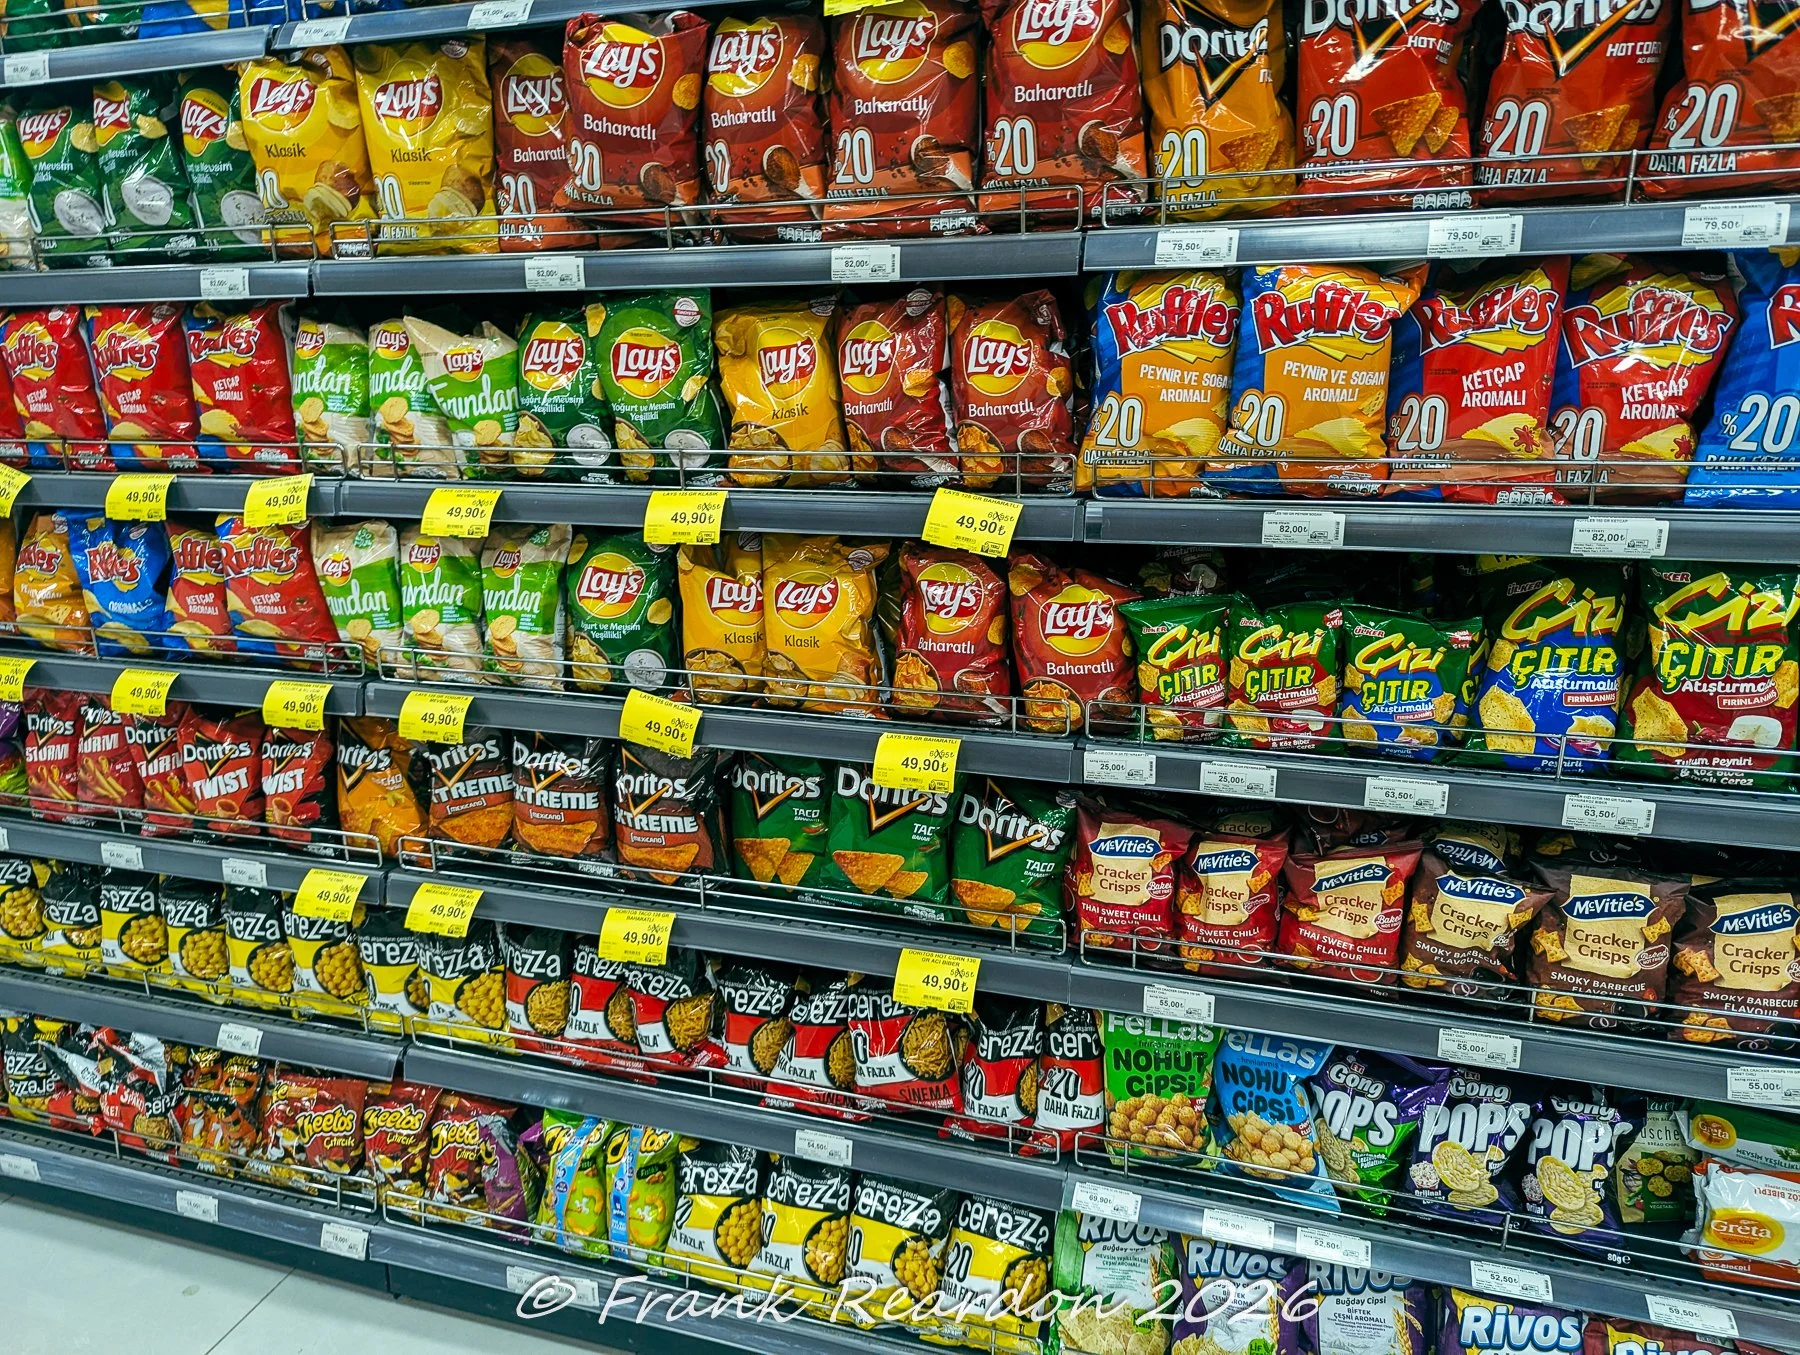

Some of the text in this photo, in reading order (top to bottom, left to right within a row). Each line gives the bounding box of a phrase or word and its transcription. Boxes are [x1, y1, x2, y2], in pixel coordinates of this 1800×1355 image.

[859, 14, 932, 62] Lay's
[1407, 36, 1435, 48] HOT
[709, 27, 776, 72] Lay's
[1606, 43, 1633, 56] HOT
[586, 42, 658, 87] Lay's
[1014, 80, 1093, 102] Baharatlı
[855, 96, 927, 115] Baharatlı
[711, 110, 776, 127] Baharatlı
[584, 115, 656, 140] Baharatlı
[265, 145, 306, 158] Klasik
[391, 147, 431, 162] Klasik
[1649, 154, 1736, 173] DAHA FAZLA
[1704, 220, 1741, 231] 79,50₺
[1447, 231, 1479, 242] 79,50₺
[1106, 284, 1240, 357] Ruffles
[1252, 282, 1401, 352] Ruffles
[1419, 284, 1558, 352] Ruffles
[1563, 286, 1733, 366] Ruffles
[616, 342, 677, 382] Lay's
[967, 336, 1030, 377] Lay's
[1183, 371, 1198, 386] VE
[1284, 361, 1346, 385] PEYNİR VE
[1462, 362, 1525, 391] KETÇAP
[1160, 387, 1211, 403] AROMALI
[1303, 387, 1357, 403] AROMALI
[1462, 391, 1526, 407] AROMALI
[649, 402, 675, 411] Mevsim
[772, 406, 809, 419] Klasik
[844, 400, 892, 416] Baharatlı
[968, 399, 1034, 417] Baharatlı
[126, 491, 161, 504] 49,90₺
[266, 494, 301, 507] 49,90₺
[446, 507, 486, 519] 49,90₺
[671, 511, 714, 525] 49,90₺
[956, 515, 1006, 536] 49,90₺
[1279, 525, 1308, 533] 82,00₺
[1592, 533, 1625, 543] 82,00₺
[580, 563, 644, 602] Lay's
[613, 622, 640, 632] Mevsim
[724, 632, 763, 645] Klasik
[785, 636, 820, 649] Klasik
[918, 638, 974, 654] Baharatlı
[1047, 661, 1114, 676] Baharatlı
[1512, 646, 1617, 688] ÇITIR
[1661, 645, 1783, 689] ÇITIR
[1159, 664, 1217, 703] ÇITIR
[1246, 666, 1312, 701] ÇITIR
[1531, 677, 1618, 692] Atıştırmalık
[1681, 677, 1776, 695] Atıştırmalık
[1259, 687, 1319, 702] Atıştırmalık
[1362, 680, 1429, 714] ÇITIR
[283, 701, 318, 714] 49,90₺
[1373, 702, 1435, 714] Atıştırmalık
[421, 711, 459, 726] 49,90₺
[644, 720, 687, 742] 49,90₺
[902, 757, 948, 773] 49,90₺
[1099, 762, 1126, 772] 25,00₺
[194, 769, 249, 800] TWIST
[1219, 774, 1245, 784] 25,00₺
[1384, 790, 1413, 800] 63,50₺
[793, 807, 820, 818] TACO
[1584, 808, 1616, 819] 63,50₺
[960, 795, 1065, 850] Doritos
[1098, 838, 1154, 854] McVitie's
[1026, 859, 1055, 872] TACO
[1096, 864, 1147, 881] Cracker
[1099, 878, 1141, 893] Crisps
[1321, 864, 1383, 891] McVitie's
[317, 891, 351, 904] 49,90₺
[1445, 878, 1515, 901] McVitie's
[1324, 893, 1378, 912] Cracker
[1573, 896, 1645, 916] McVitie's
[1082, 903, 1161, 922] THAI SWEET CHILLI
[1328, 907, 1369, 926] Crisps
[1440, 904, 1502, 932] Cracker
[1722, 908, 1792, 932] McVitie's
[623, 930, 663, 946] 49,90₺
[1199, 926, 1260, 938] SWEET CHILLI
[1442, 919, 1489, 940] Crisps
[1197, 936, 1241, 946] FLAVOUR
[1298, 927, 1388, 956] THAI SWEET CHILLI
[1573, 930, 1640, 950] Cracker
[1316, 944, 1363, 962] FLAVOUR
[1415, 940, 1450, 958] SMOKY
[1577, 944, 1631, 964] Crisps
[1722, 943, 1790, 961] Cracker
[1434, 955, 1481, 966] FLAVOUR
[1729, 959, 1781, 978] Crisps
[923, 973, 969, 993] 49,90₺
[1551, 971, 1646, 993] SMOKY BARBECUE
[1159, 998, 1184, 1009] 55,00₺
[1703, 991, 1799, 1009] SMOKY BARBECUE
[1457, 1043, 1486, 1054] 55,00₺
[1114, 1049, 1207, 1074] NOHUT
[1331, 1063, 1385, 1098] Gong
[1748, 1081, 1781, 1091] 55,00₺
[1450, 1078, 1511, 1102] Gong
[1045, 1098, 1069, 1115] DAHA
[1189, 1243, 1288, 1276] Rivos
[1490, 1273, 1519, 1284] 52,50₺
[1335, 1297, 1387, 1308] Buğday Cipsi
[1355, 1314, 1387, 1325] AROMALI
[1461, 1306, 1580, 1347] Rivos
